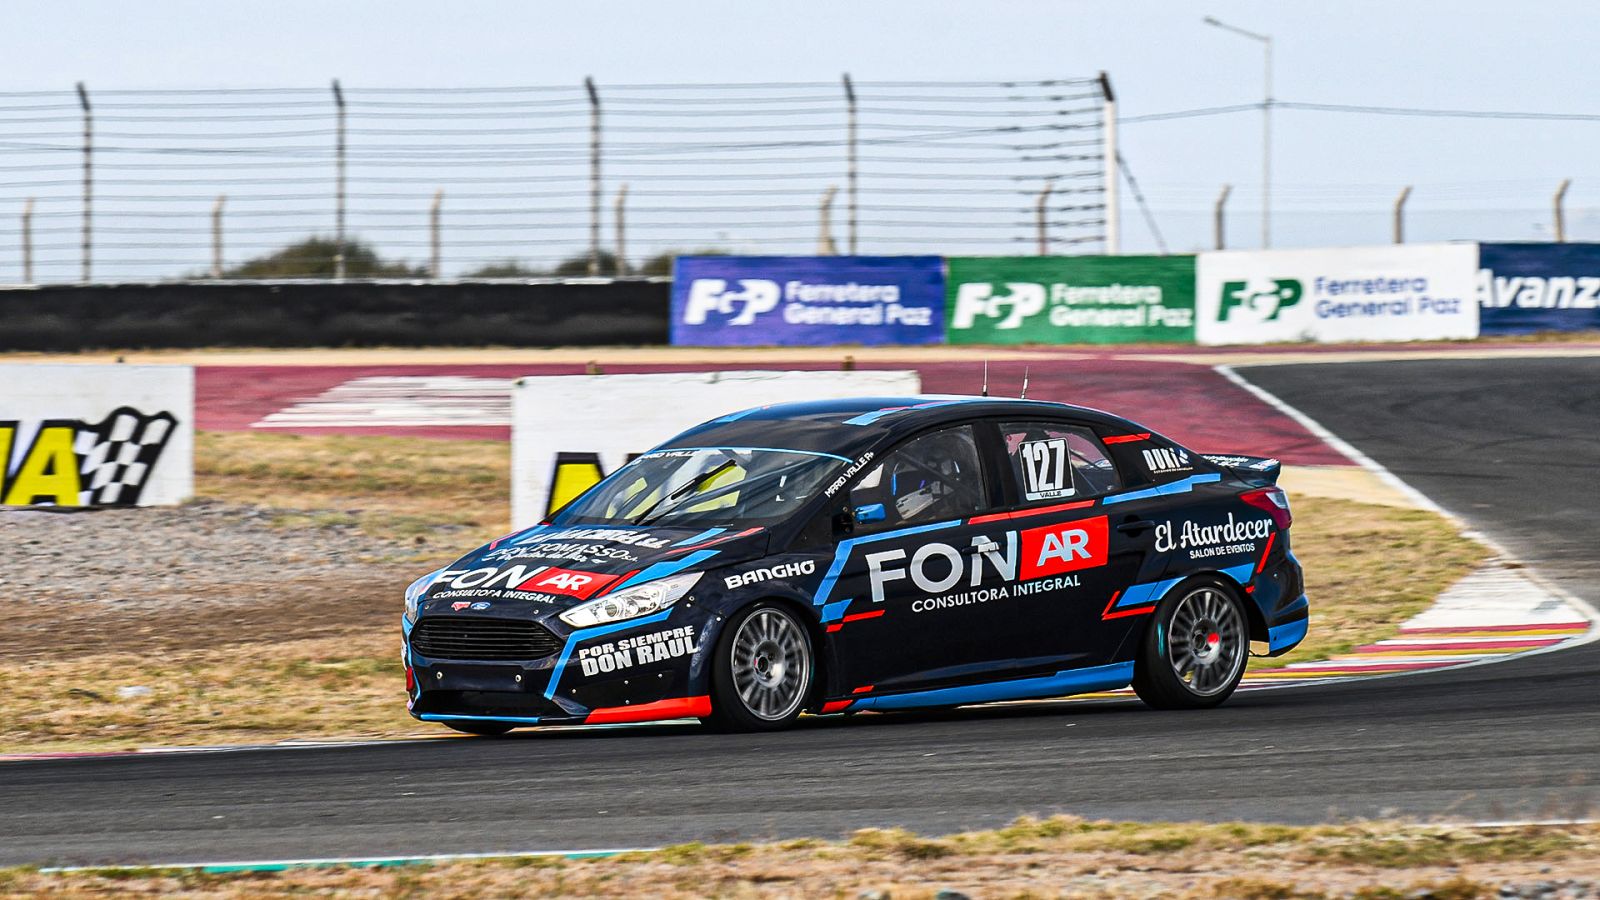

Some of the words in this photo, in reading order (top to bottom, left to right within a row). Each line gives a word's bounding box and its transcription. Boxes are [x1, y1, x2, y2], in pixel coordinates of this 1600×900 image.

[785, 280, 900, 302] Ferretera
[1051, 283, 1163, 305] Ferretera
[1314, 276, 1426, 296] Ferretera
[1476, 269, 1600, 308] Avanz
[784, 303, 883, 326] General
[886, 303, 932, 326] Paz
[1050, 305, 1146, 327] General
[1149, 305, 1193, 327] Paz
[1314, 299, 1413, 319] General
[1417, 296, 1461, 316] Paz
[1022, 439, 1066, 493] 127
[824, 476, 847, 498] MARIO
[843, 460, 868, 478] VALLE
[1039, 490, 1063, 498] VALLE
[1155, 520, 1177, 552] El
[1180, 511, 1273, 549] Atardecer
[1189, 546, 1215, 559] SALON
[1216, 545, 1226, 555] DE
[1226, 543, 1255, 555] EVENTOS
[865, 531, 1018, 603] FON
[1036, 528, 1092, 567] AR
[424, 565, 549, 592] FON
[536, 573, 593, 590] AR
[433, 590, 501, 599] CONSULTORA
[502, 591, 556, 604] INTEGRAL
[911, 588, 1010, 613] CONSULTORA
[1013, 574, 1081, 597] INTEGRAL
[579, 643, 614, 659] POR
[618, 625, 695, 651] SIEMPRE
[580, 649, 633, 677] DON
[636, 635, 701, 665] RAUL
